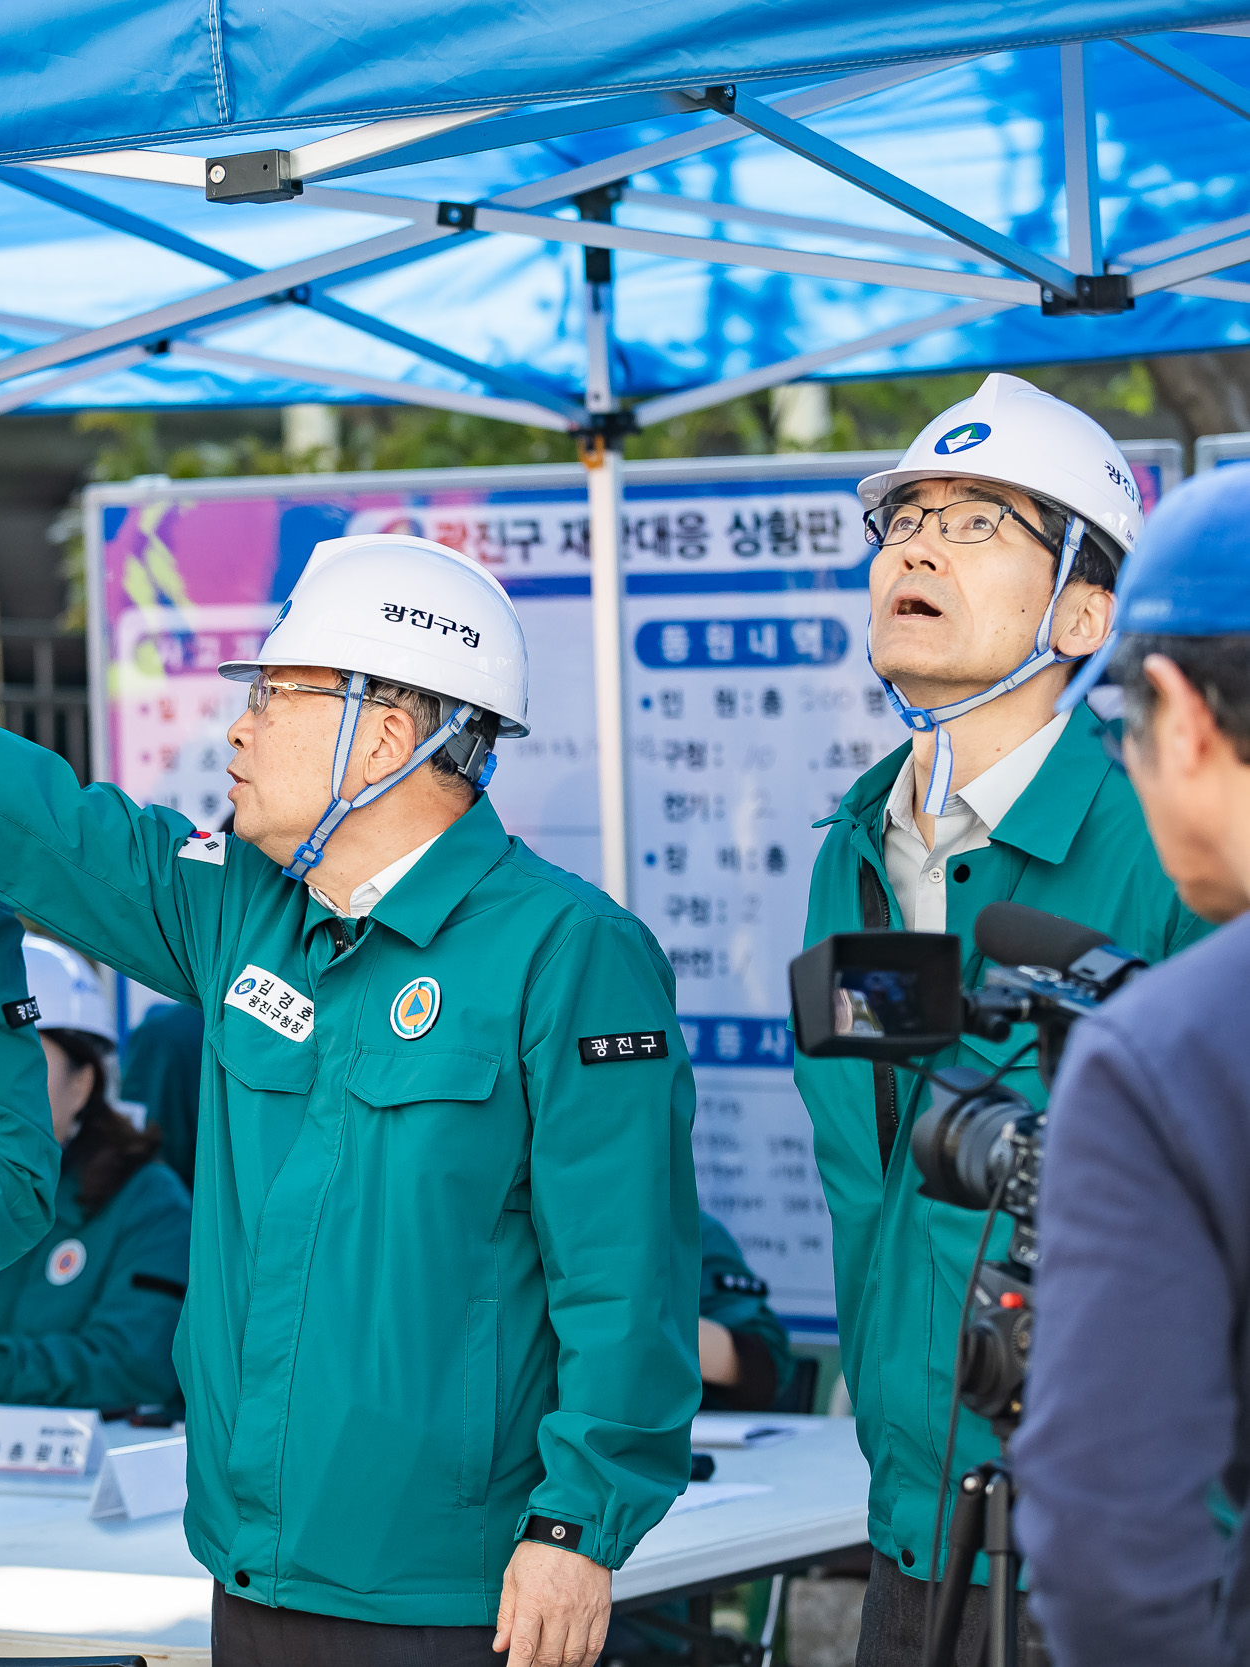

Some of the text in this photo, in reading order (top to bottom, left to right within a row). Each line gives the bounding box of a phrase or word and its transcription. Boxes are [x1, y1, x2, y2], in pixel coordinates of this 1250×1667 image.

[559, 513, 710, 561] 재대응
[726, 506, 842, 558] 상황판
[380, 602, 480, 648] 광진구청
[248, 995, 304, 1034] 광진구청장
[258, 979, 314, 1022] 김경호
[591, 1036, 657, 1057] 광진구
